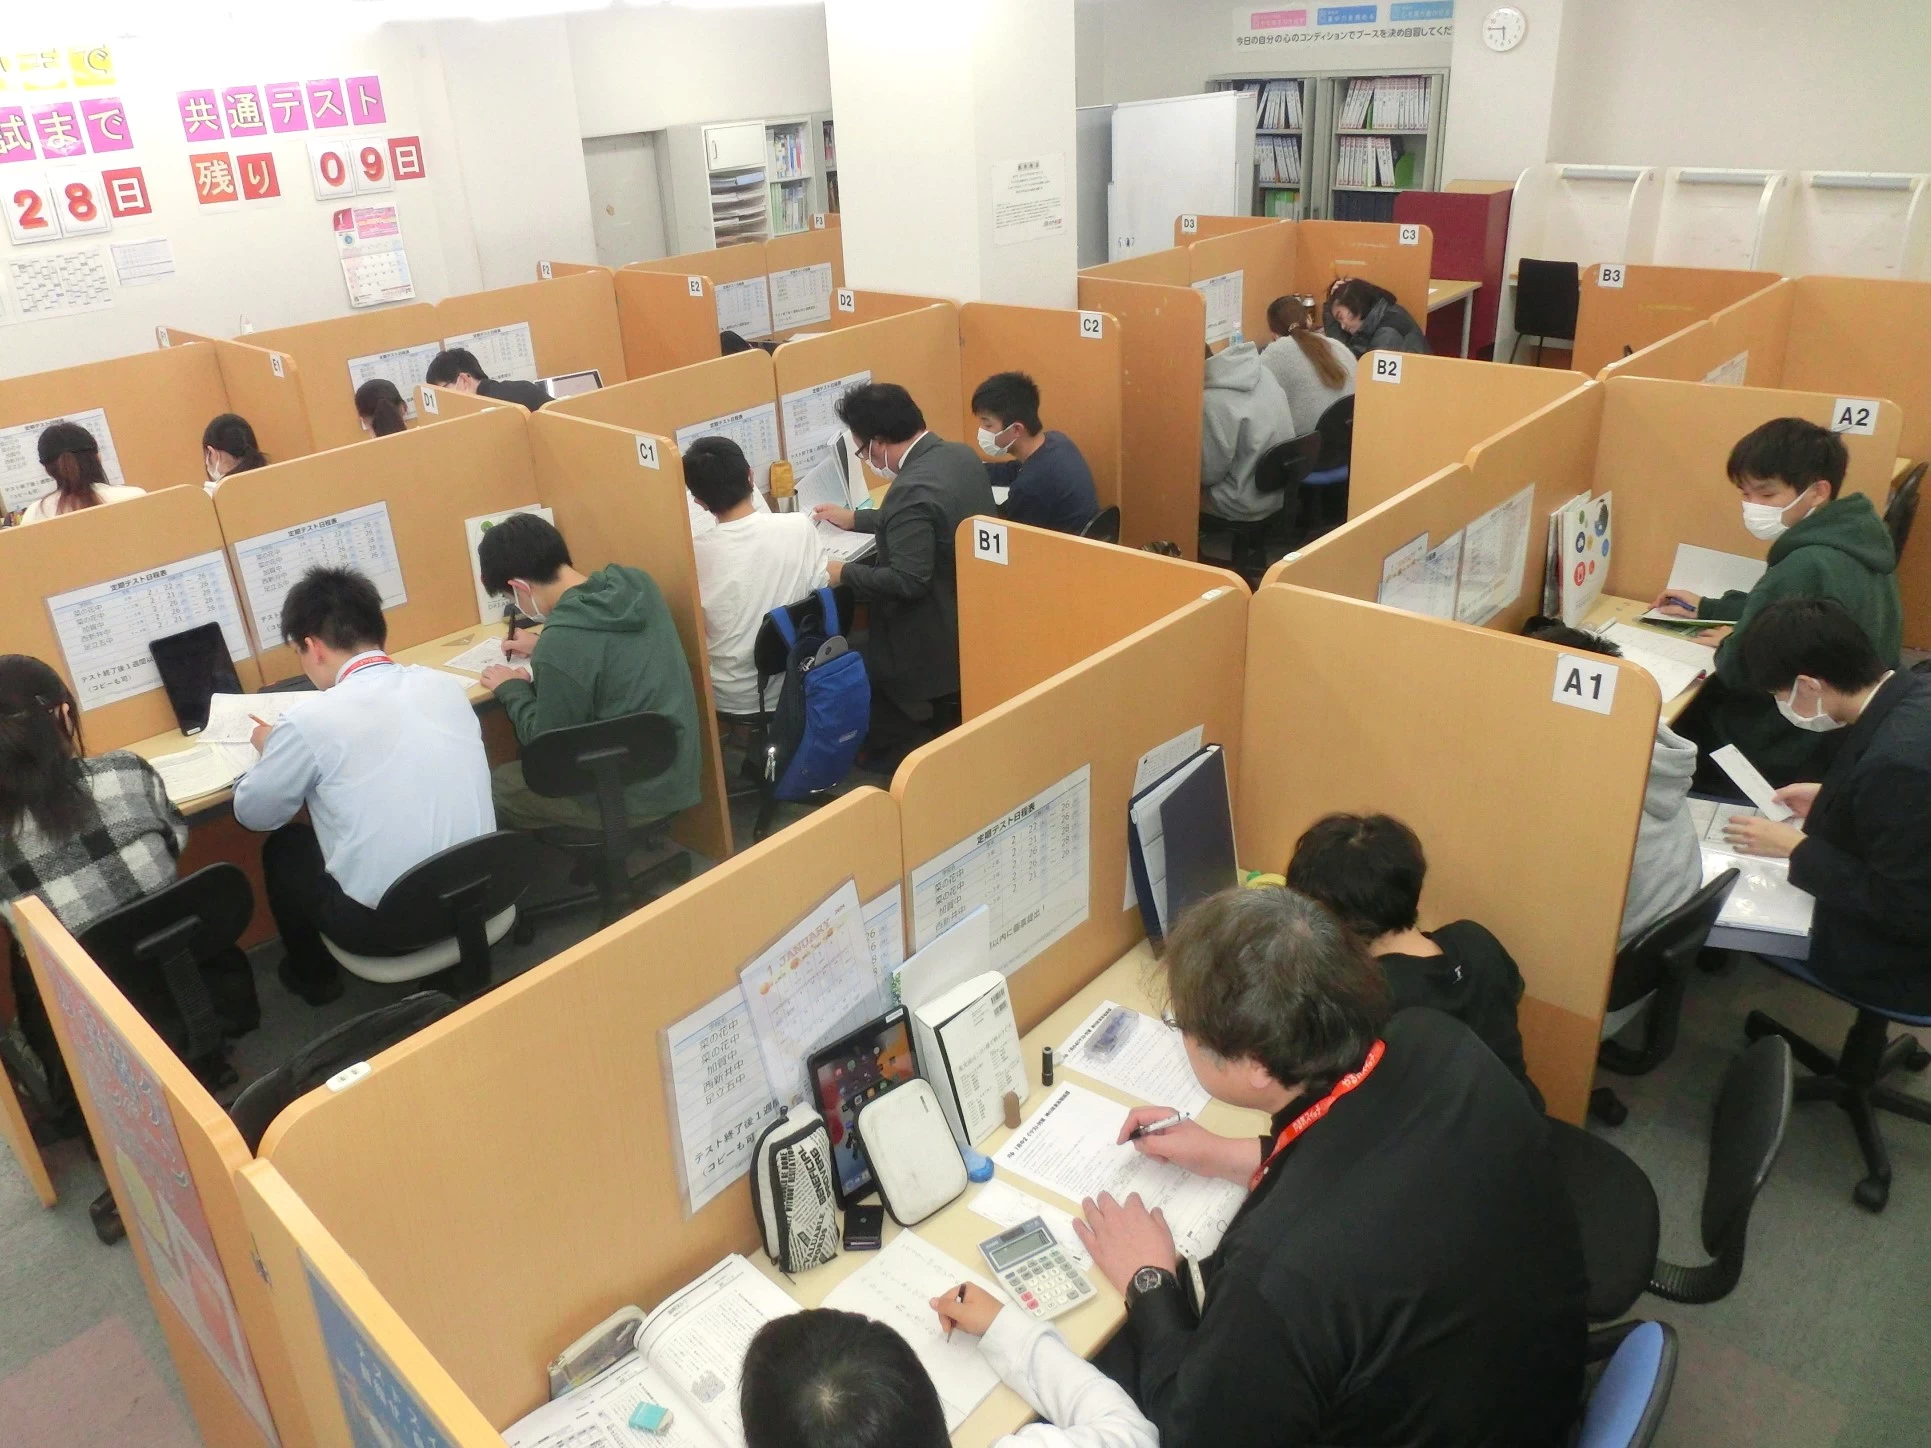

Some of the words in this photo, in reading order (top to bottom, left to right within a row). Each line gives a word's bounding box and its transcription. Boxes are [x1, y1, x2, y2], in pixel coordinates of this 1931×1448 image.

[185, 86, 378, 133] 共通テスト
[197, 159, 271, 196] 残り
[815, 216, 823, 226] F3
[1183, 218, 1195, 229] D3
[1402, 229, 1416, 240] C3
[690, 280, 701, 292] E2
[1603, 268, 1621, 282] B3
[840, 293, 852, 307] D2
[1083, 318, 1100, 333] C2
[272, 358, 281, 372] E1
[1377, 358, 1397, 377] B2
[424, 392, 435, 409] D1
[1838, 406, 1870, 427] A2
[639, 442, 655, 462] C1
[288, 518, 339, 538] 定期テスト日程表
[979, 529, 1000, 554] B1
[110, 569, 168, 592] 定期テスト日程表
[1562, 667, 1603, 701] A1
[976, 802, 1036, 845] 定期テスト日程表
[779, 918, 831, 968] JANUARY
[700, 1019, 739, 1050] 菜の花中
[702, 1033, 740, 1064] 菜の花中
[707, 1050, 737, 1076] 加賀中
[703, 1060, 744, 1093] 西新井中
[706, 1073, 745, 1105] 足立五中
[1292, 1104, 1323, 1133] やる気スイッチ
[798, 1144, 827, 1206] BENEFICIAL
[809, 1147, 832, 1200] PROVERB
